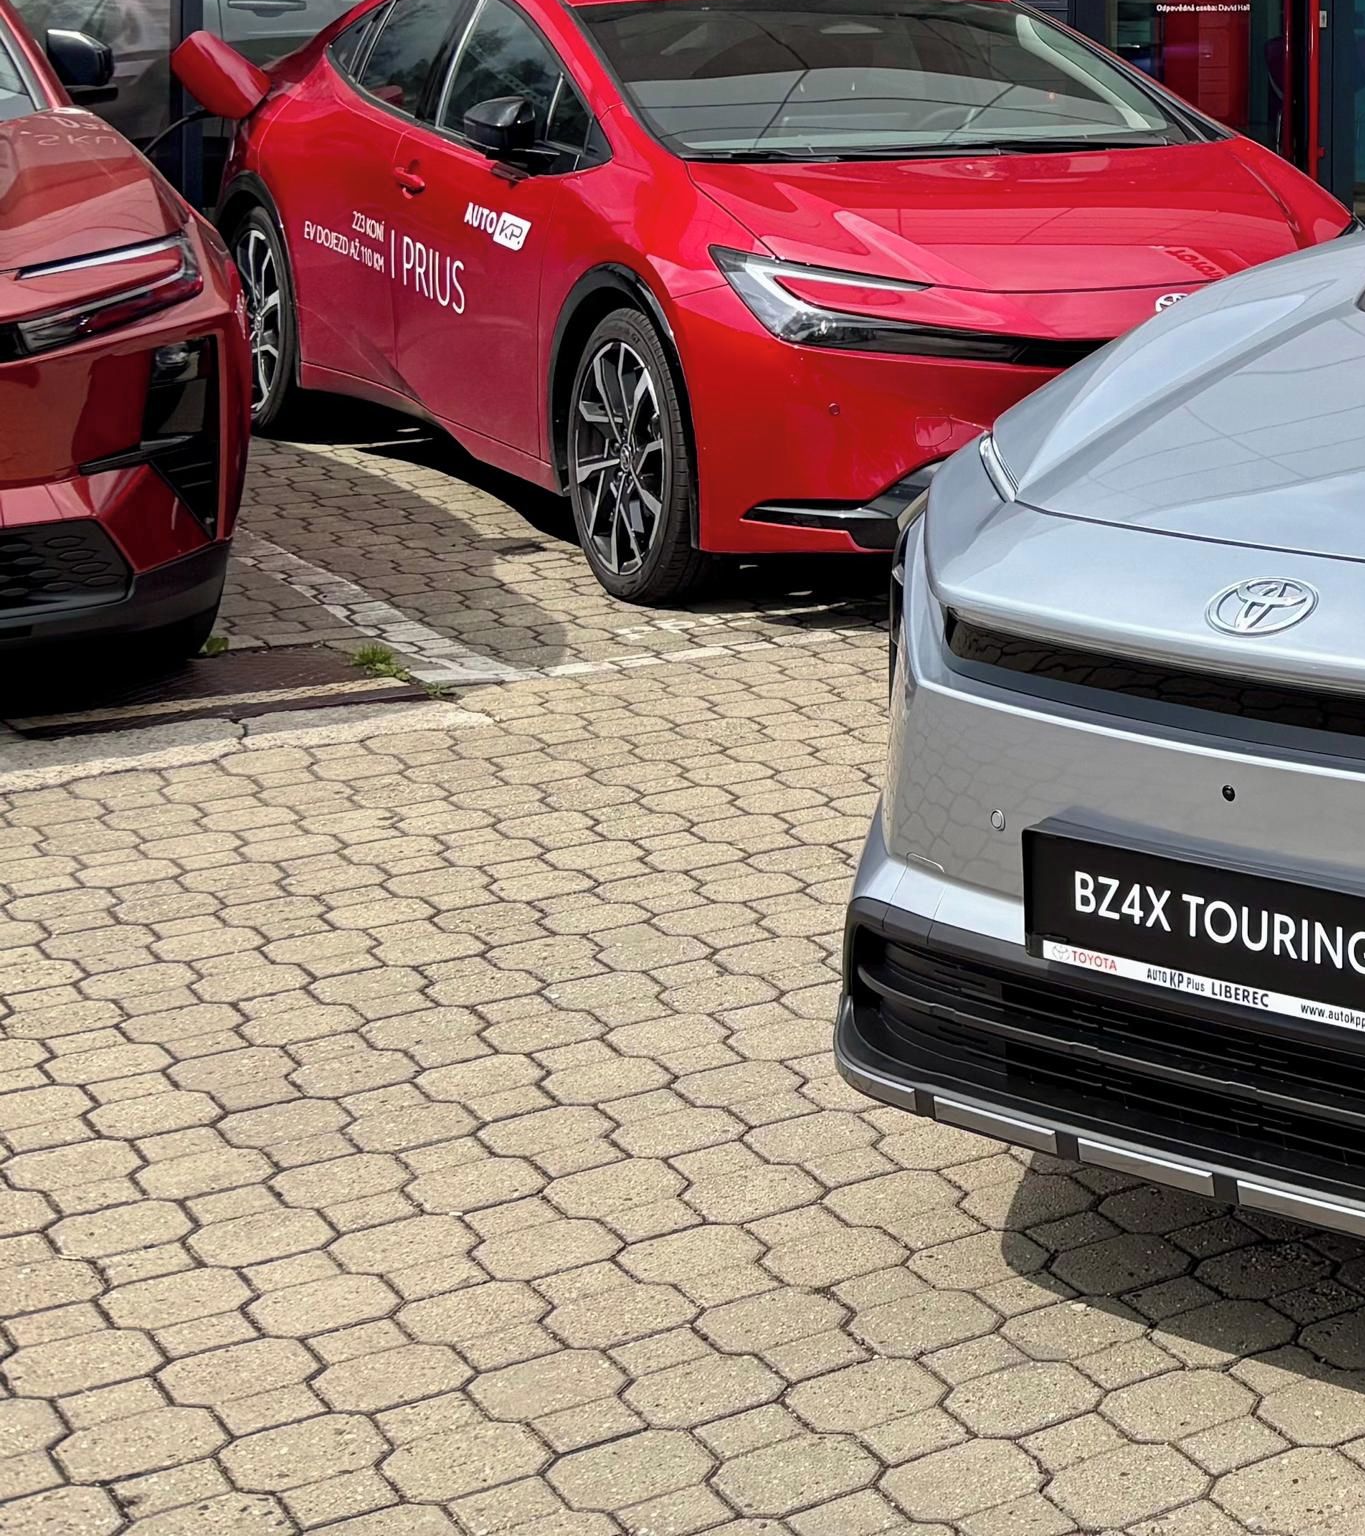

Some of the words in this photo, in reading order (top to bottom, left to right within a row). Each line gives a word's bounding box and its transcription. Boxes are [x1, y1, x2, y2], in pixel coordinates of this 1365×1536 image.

[352, 210, 366, 233] 223
[366, 220, 385, 243] KONÍ
[464, 202, 497, 234] AUTO
[304, 221, 316, 240] EV
[316, 226, 349, 255] DOJEZD
[350, 238, 361, 261] AŽ
[361, 245, 373, 268] 110
[373, 252, 385, 273] KM
[403, 235, 465, 315] PRIUS
[1074, 870, 1172, 932] BZ4X
[1071, 949, 1118, 972] TOYOTA
[1147, 967, 1168, 984] AUTO
[1169, 970, 1184, 990] KP
[1186, 977, 1206, 993] Plus
[1211, 981, 1270, 1008] LIBEREC
